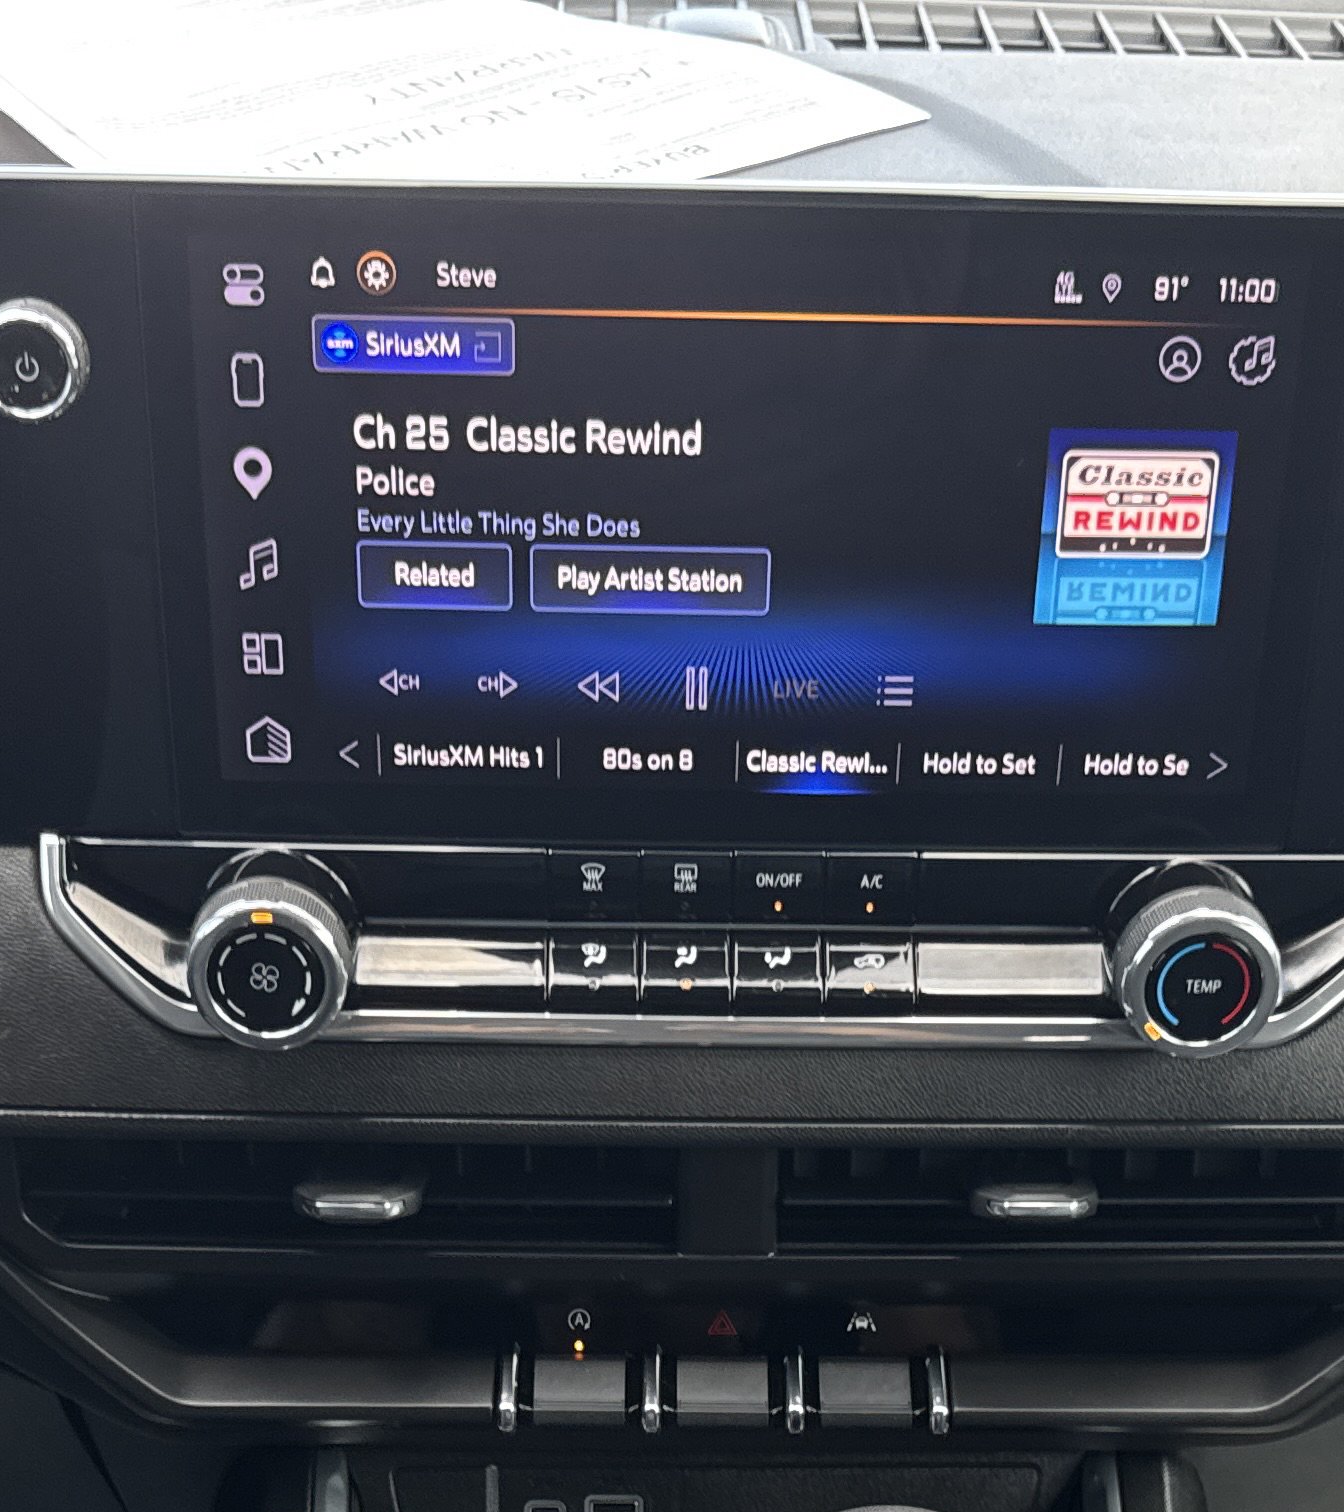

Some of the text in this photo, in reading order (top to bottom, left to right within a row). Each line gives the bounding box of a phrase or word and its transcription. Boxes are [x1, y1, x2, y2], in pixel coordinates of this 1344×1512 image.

[436, 261, 496, 288] Steve
[1155, 276, 1190, 301] 91°
[1219, 277, 1276, 303] 11:00
[365, 330, 461, 358] SiriusXM
[353, 415, 702, 456] Ch 25 Classic Rewind
[357, 466, 435, 497] Police
[1078, 464, 1204, 487] Classic
[358, 510, 640, 540] Every Little Thing She Does
[1073, 510, 1200, 531] REWIND
[394, 561, 475, 587] Related
[557, 565, 742, 594] Play Artist Station
[399, 674, 420, 690] CH
[477, 675, 498, 692] CH
[773, 678, 819, 699] LIVE
[393, 742, 543, 769] SiriusXM Hits 1
[603, 748, 693, 771] 80s on 8
[746, 749, 817, 774] Classic
[923, 753, 1036, 776] Hold to Set
[1084, 754, 1129, 776] Hold
[1131, 756, 1159, 776] to
[582, 881, 603, 892] MAX
[674, 882, 697, 893] REAR
[756, 873, 802, 889] ON/OFF
[860, 874, 883, 890] A/C
[1186, 979, 1223, 994] TEMP
